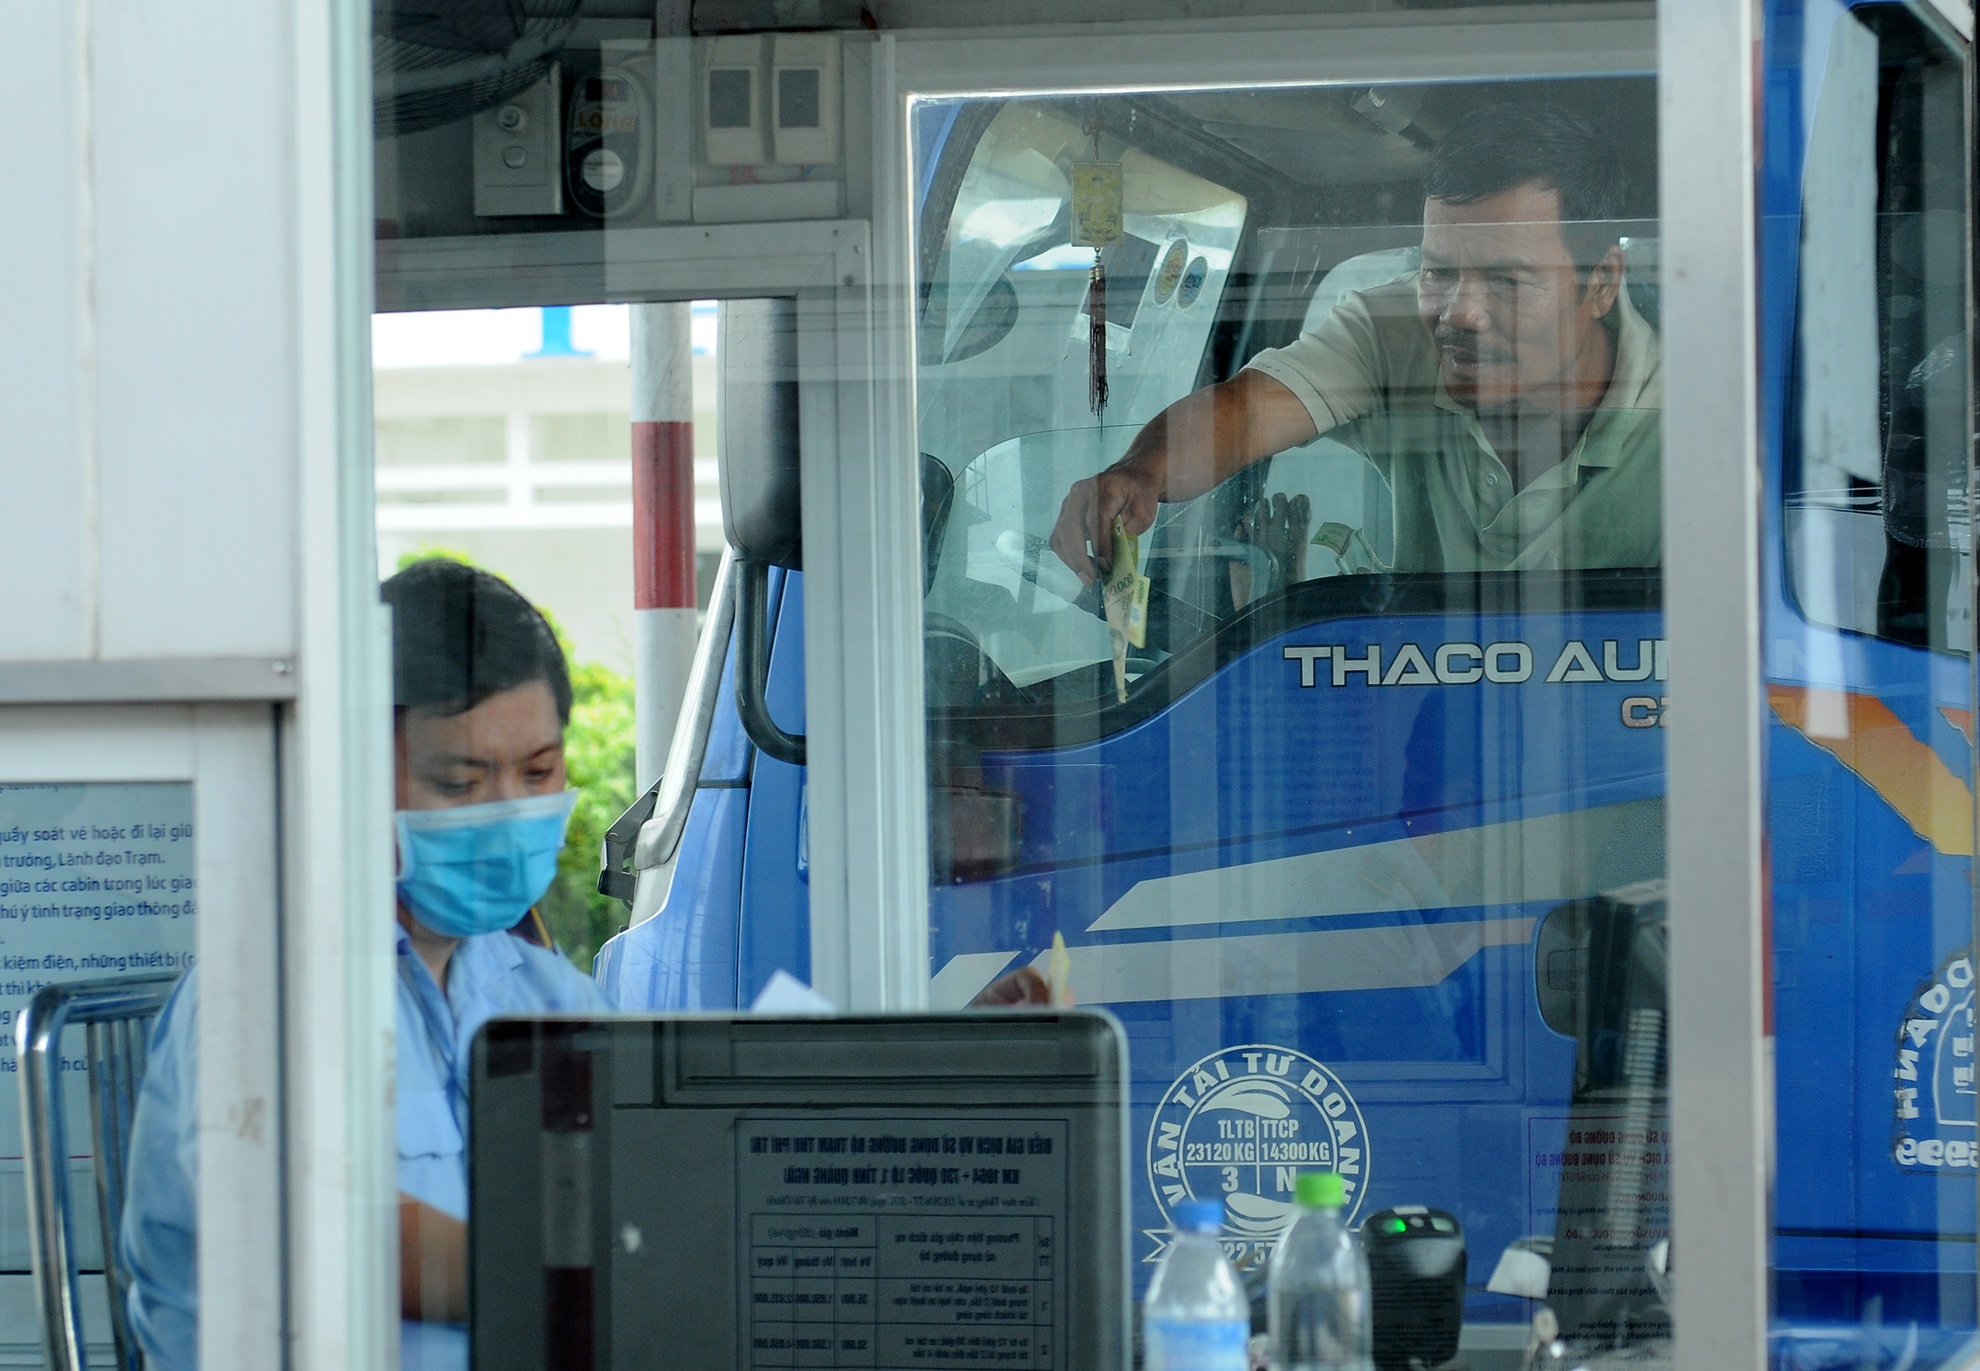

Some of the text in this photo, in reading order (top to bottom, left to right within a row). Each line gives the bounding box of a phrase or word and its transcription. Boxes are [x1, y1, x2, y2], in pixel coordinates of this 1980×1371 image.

[1283, 640, 1534, 687] THACO
[34, 826, 65, 841] soát
[70, 826, 87, 840] vé
[92, 825, 126, 842] hoặc
[149, 825, 166, 842] lại
[96, 850, 122, 868] đạo
[35, 879, 57, 892] các
[62, 877, 100, 892] cabin
[104, 876, 142, 894] trong
[147, 875, 166, 889] lúc
[63, 904, 101, 920] trạng
[104, 902, 135, 920] giao
[137, 900, 180, 919] thông
[5, 955, 40, 972] kiệm
[82, 952, 126, 972] những
[129, 951, 163, 968] thiết
[1153, 1052, 1361, 1208] VẬN TẢI TƯ DOANH
[1218, 1119, 1299, 1139] TLTB TTCP
[1186, 1142, 1330, 1162] 23120 KG 14300 KG
[1221, 1166, 1239, 1192] 3
